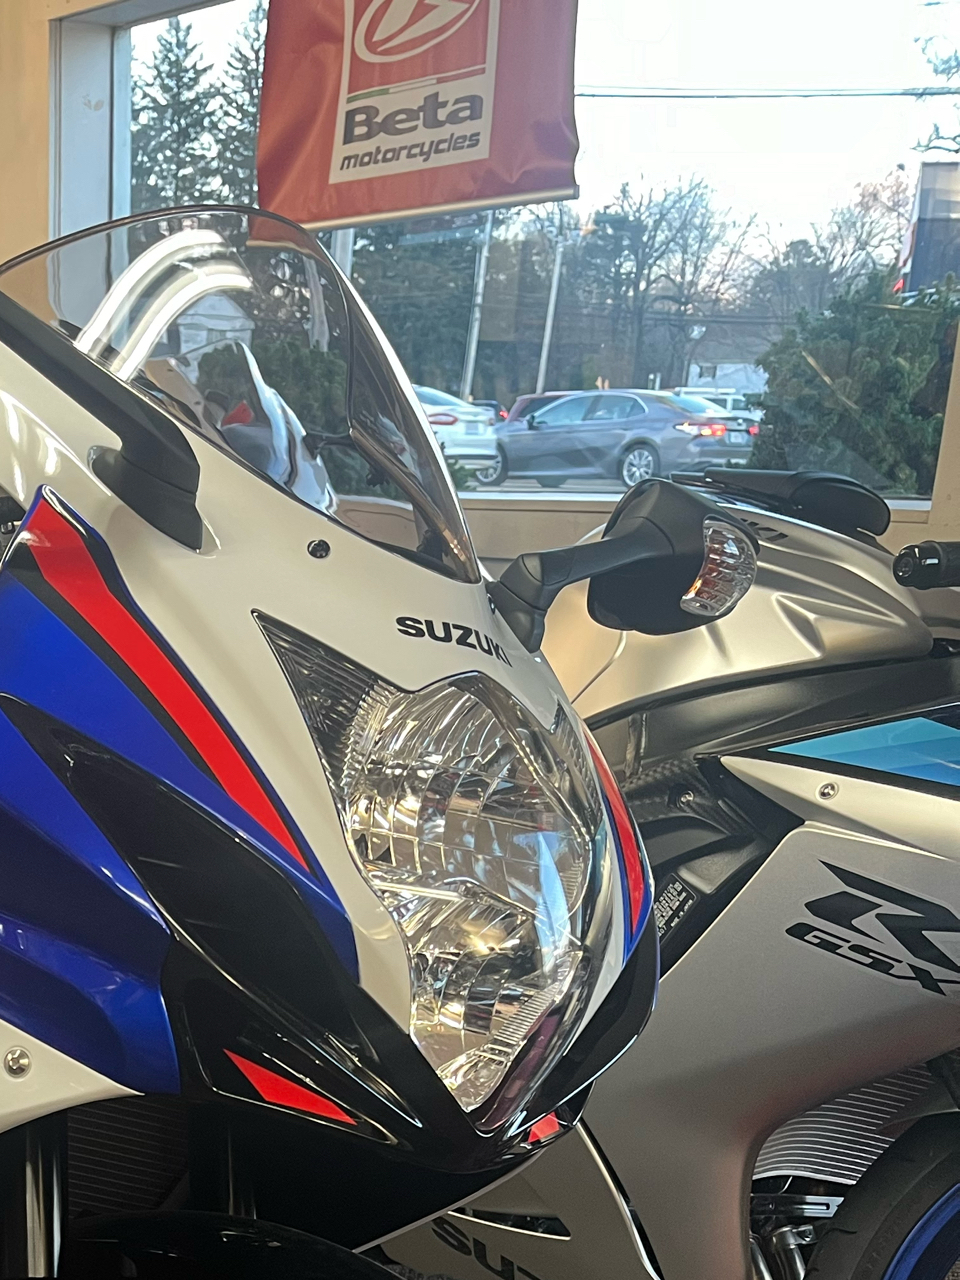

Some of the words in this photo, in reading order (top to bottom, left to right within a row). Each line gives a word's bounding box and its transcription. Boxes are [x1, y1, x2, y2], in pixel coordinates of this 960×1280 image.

[342, 91, 484, 146] Beta
[339, 131, 481, 171] motorcycles
[395, 616, 513, 668] SUZUKI
